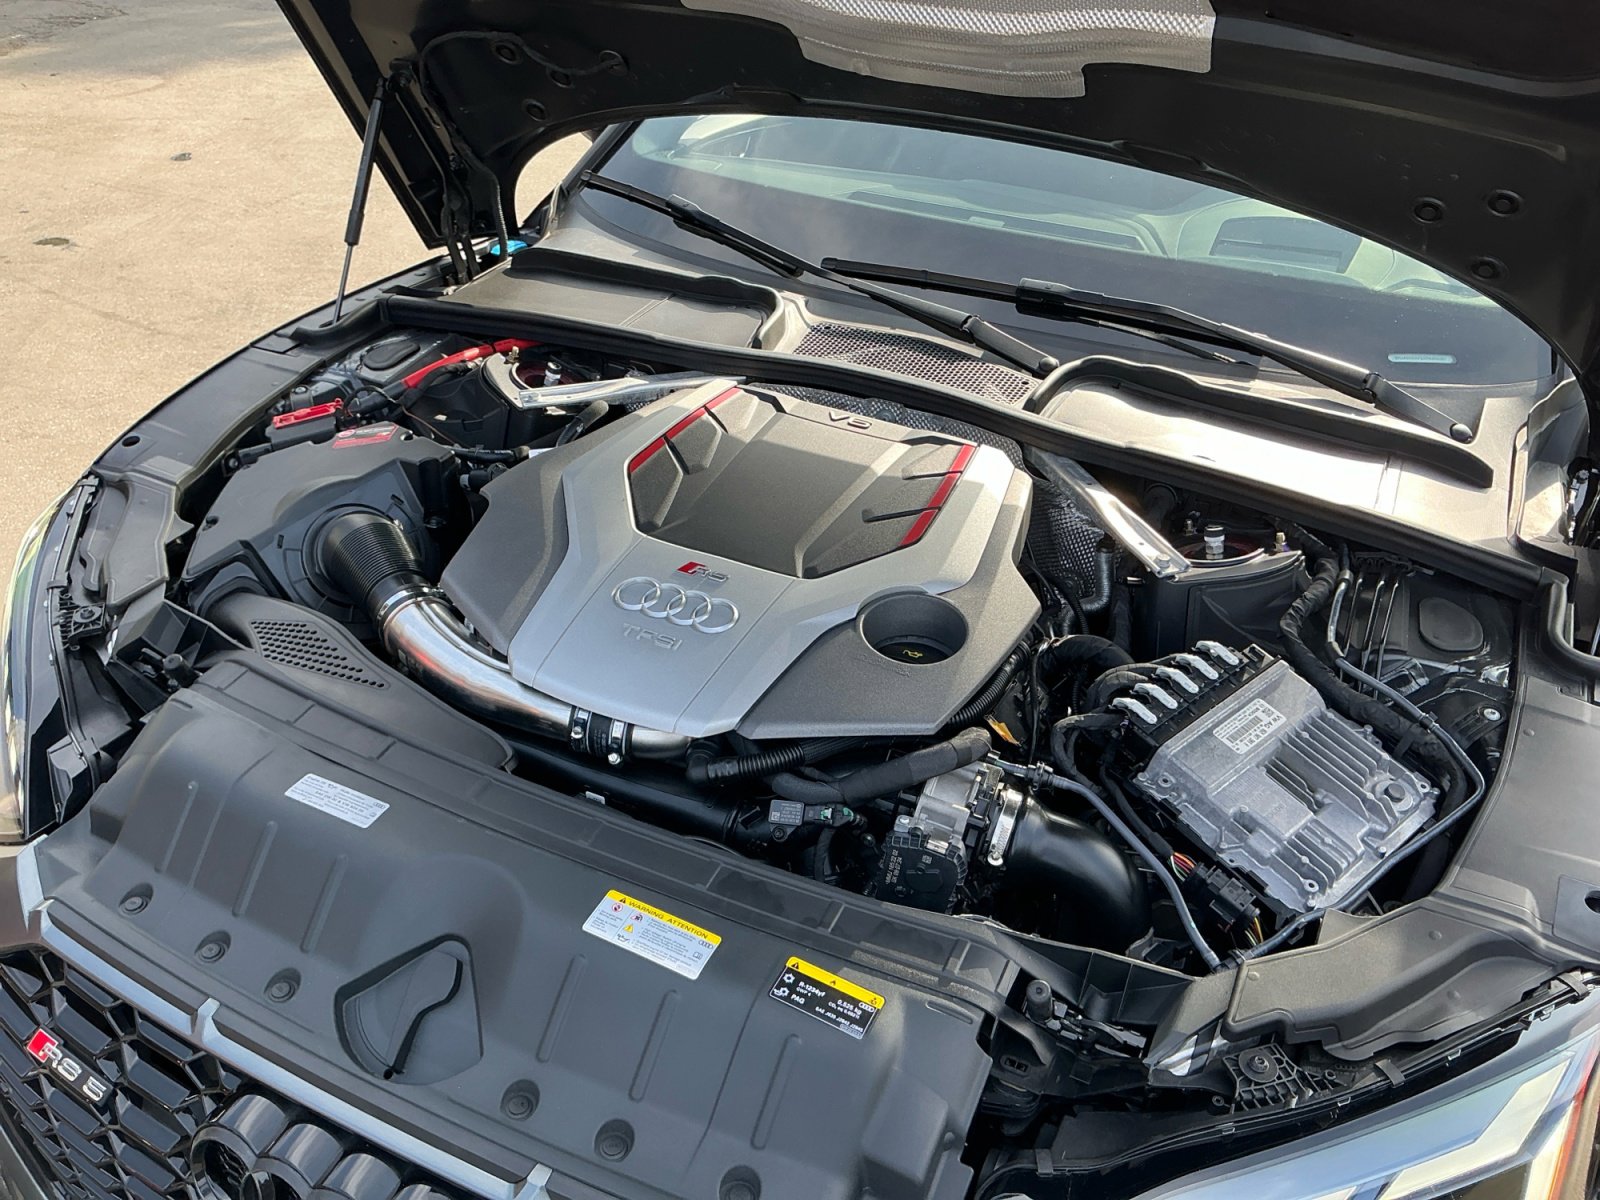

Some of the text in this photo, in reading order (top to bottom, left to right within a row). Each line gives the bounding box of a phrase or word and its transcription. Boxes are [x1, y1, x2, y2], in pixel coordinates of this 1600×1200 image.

[829, 410, 872, 430] V6
[678, 561, 730, 583] RS
[623, 623, 683, 650] TFSI
[628, 900, 664, 920] WARNING
[667, 917, 709, 939] ATTENTION
[790, 993, 805, 1004] PAG
[31, 1034, 107, 1101] RS 5
